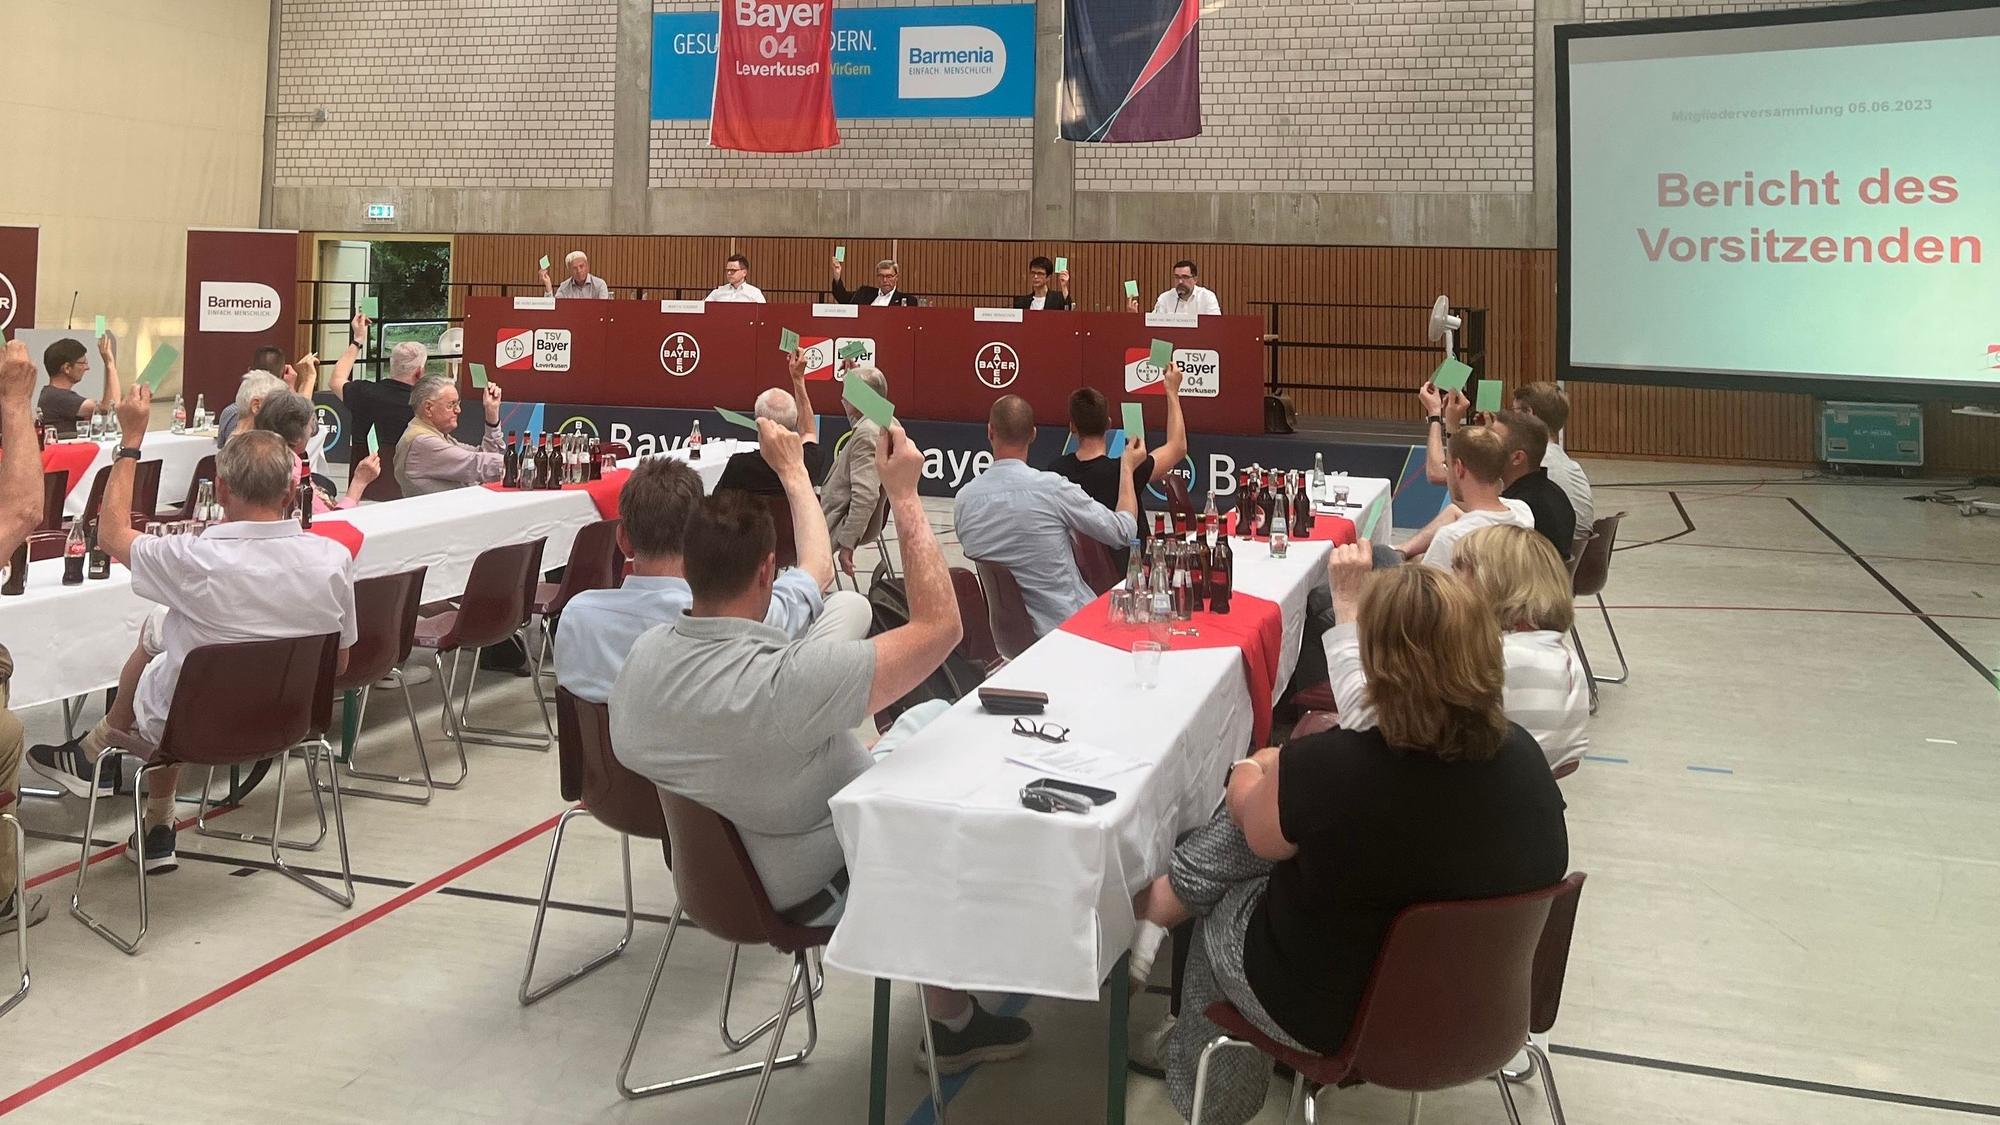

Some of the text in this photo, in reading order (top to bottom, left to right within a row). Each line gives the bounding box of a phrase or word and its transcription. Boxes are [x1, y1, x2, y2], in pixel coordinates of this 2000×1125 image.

[735, 0, 825, 33] Bayer
[674, 33, 718, 54] GESU
[759, 35, 797, 59] 04
[909, 46, 994, 64] Barmenia
[736, 60, 820, 76] Leverkusen
[1671, 99, 1933, 123] Mitgliederversammlung 05.06.2023
[1656, 167, 1959, 207] Bericht des
[1636, 226, 1982, 264] Vorsitzenden
[208, 296, 271, 309] Barmenia
[544, 332, 562, 340] TSV
[536, 339, 569, 352] Bayer
[545, 353, 558, 362] 04
[663, 350, 697, 359] BAYER
[1184, 352, 1206, 362] TSV
[979, 360, 1016, 370] BAYER
[1176, 360, 1216, 376] Bayer
[1187, 376, 1204, 386] 04
[921, 447, 994, 488] aye
